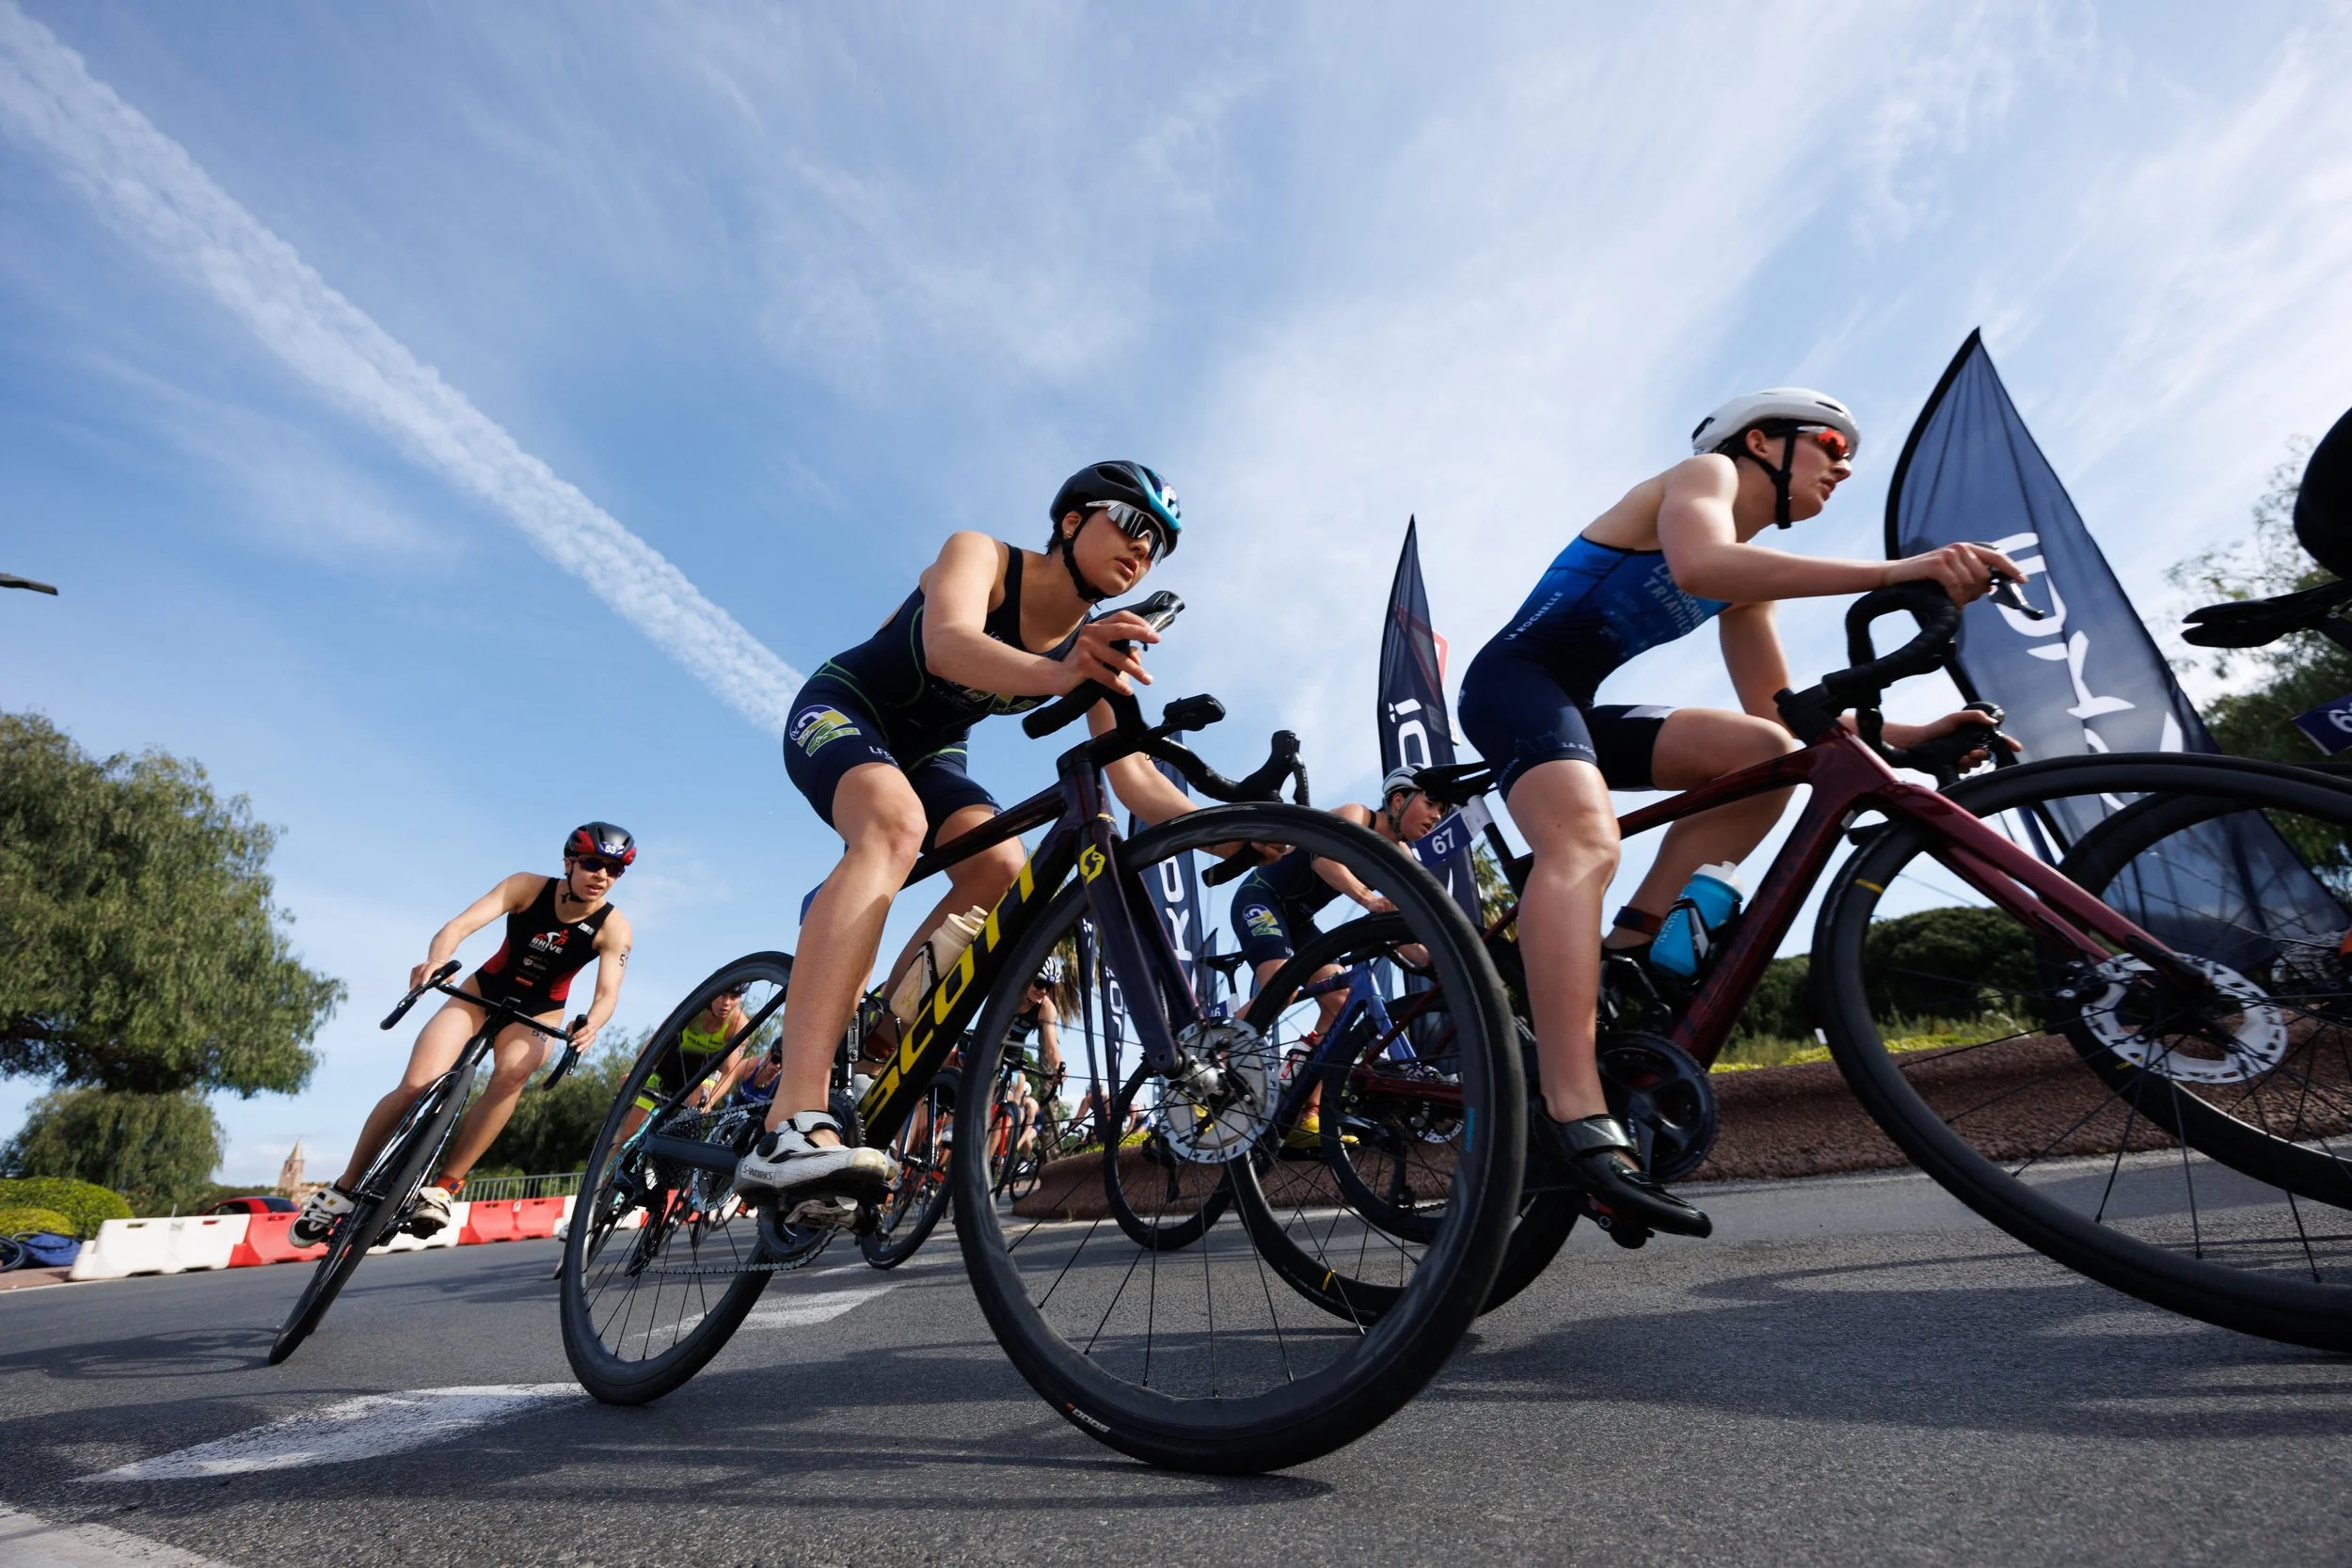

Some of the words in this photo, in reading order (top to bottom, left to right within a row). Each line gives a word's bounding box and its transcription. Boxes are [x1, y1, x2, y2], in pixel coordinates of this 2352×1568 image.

[1516, 591, 1564, 632] ROCHELLE
[1643, 577, 1692, 635] TRIATHLO
[2328, 702, 2352, 734] 6
[604, 844, 617, 855] 53
[1431, 827, 1455, 855] 67
[531, 937, 564, 955] BRIVE
[859, 843, 1041, 1130] SCOTT
[742, 1165, 774, 1180] S-WORKS
